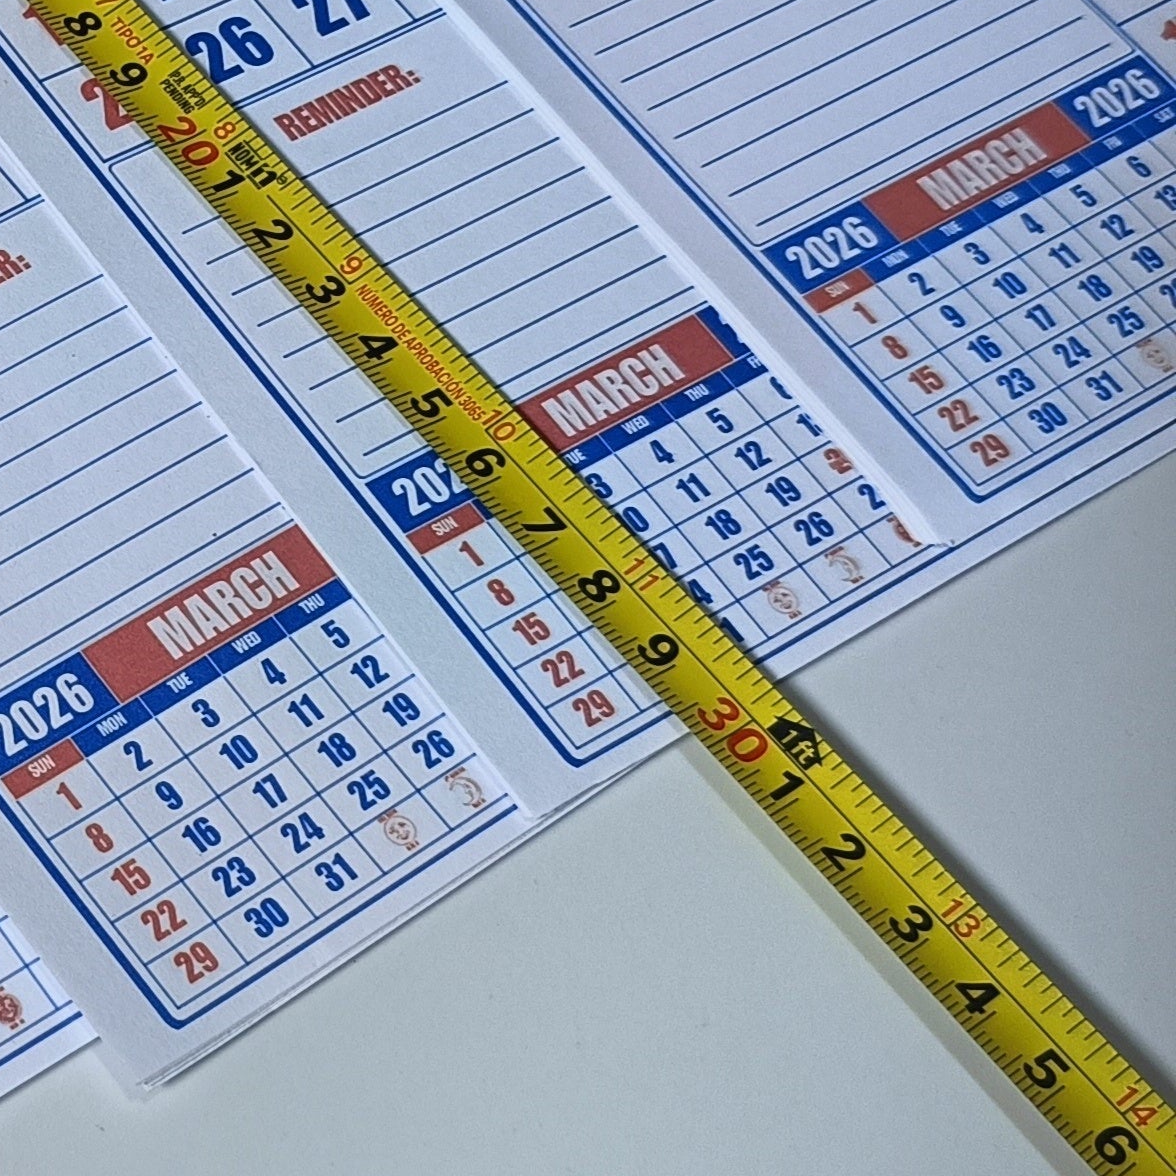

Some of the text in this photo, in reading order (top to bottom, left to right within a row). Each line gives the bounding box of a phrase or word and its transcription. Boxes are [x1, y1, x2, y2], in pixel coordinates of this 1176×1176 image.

[160, 79, 196, 115] PENDING
[273, 64, 422, 142] REMINDER:
[157, 116, 220, 166] 20
[785, 68, 1162, 281] 2026 MARCH 2026
[356, 284, 486, 422] NÚMERO DE APROBACIÓN 3065
[542, 343, 686, 438] MARCH
[146, 550, 300, 661] MARCH
[230, 594, 326, 654] WED THU
[697, 696, 769, 763] 30
[941, 898, 982, 940] 13
[955, 980, 1000, 1014] 4
[1024, 1047, 1069, 1088] 5
